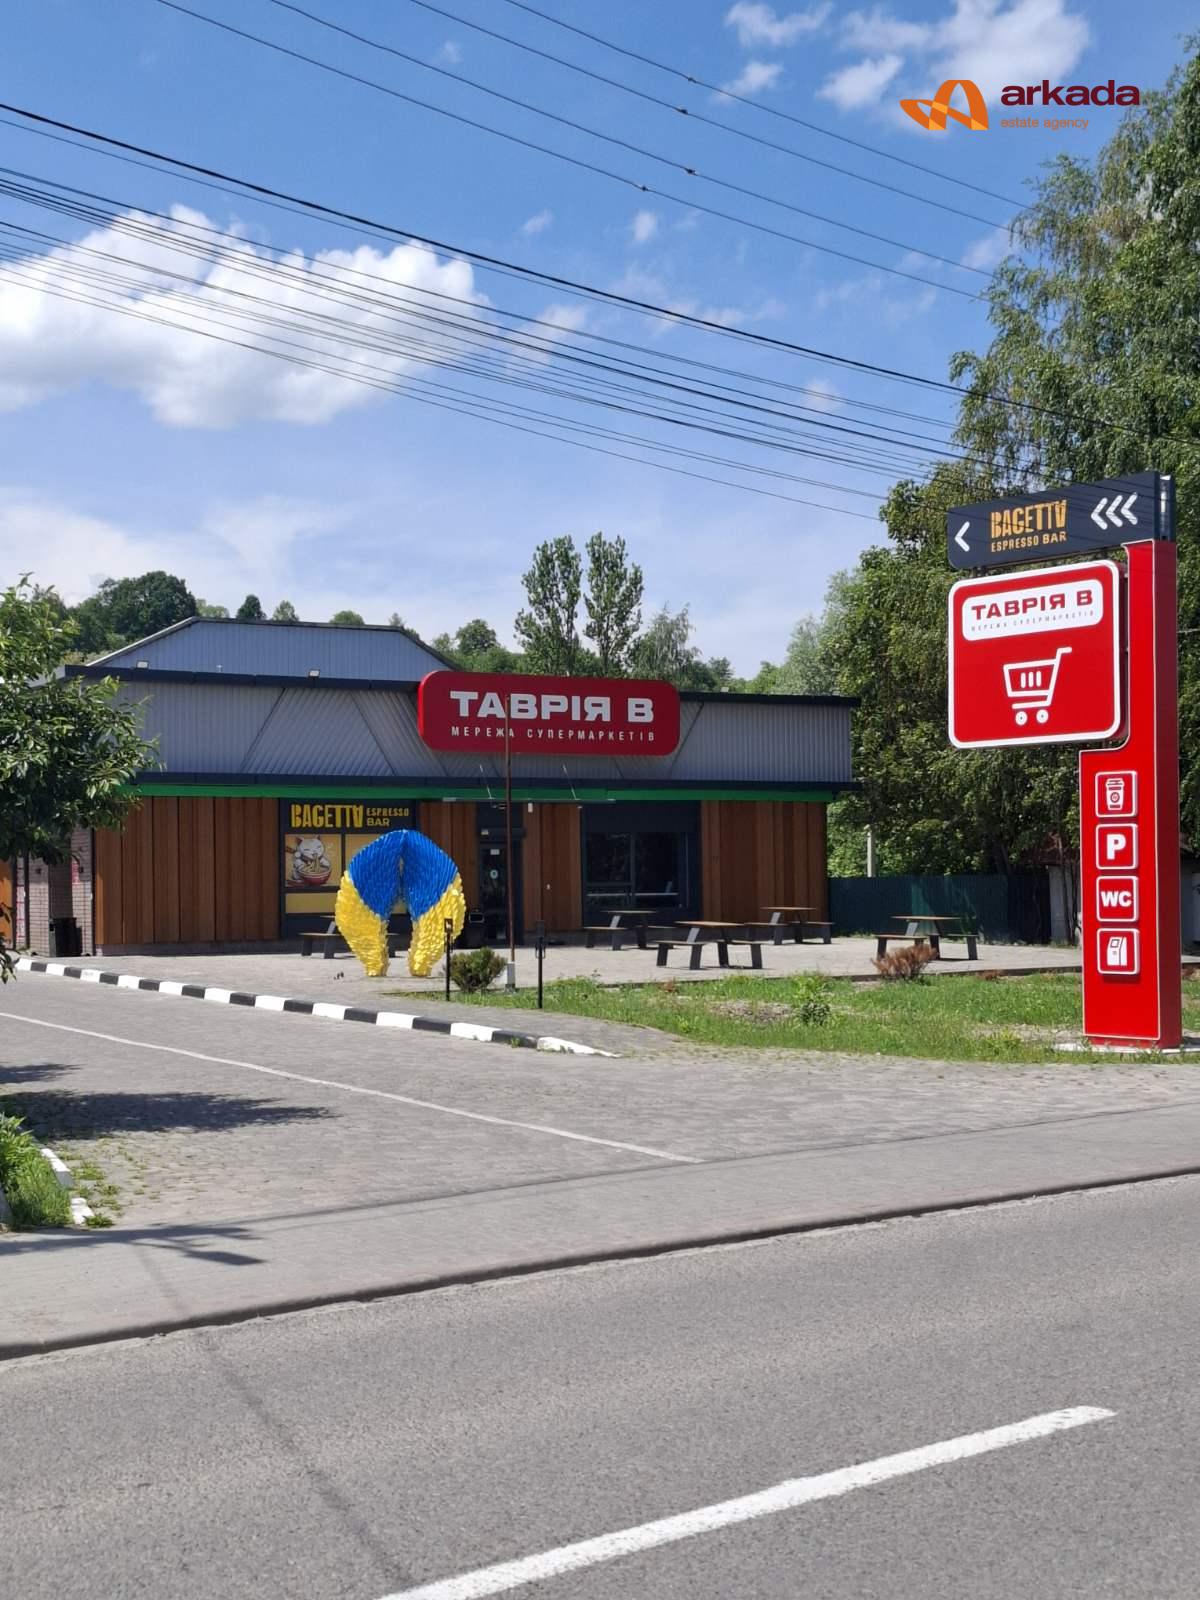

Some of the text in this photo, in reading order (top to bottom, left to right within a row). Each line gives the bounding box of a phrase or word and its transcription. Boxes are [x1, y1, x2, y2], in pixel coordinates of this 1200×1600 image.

[991, 531, 1067, 552] ESPRESSO BAR
[971, 590, 1093, 620] ТАВРІЯ В
[450, 691, 654, 723] ТАВРІЯ В
[451, 726, 655, 741] МЕРЕЖА СУПЕРМАРКЕТІВ
[366, 807, 410, 817] ESPRESSO
[366, 817, 390, 826] BAR
[1106, 834, 1126, 860] P
[1101, 891, 1132, 907] WC
